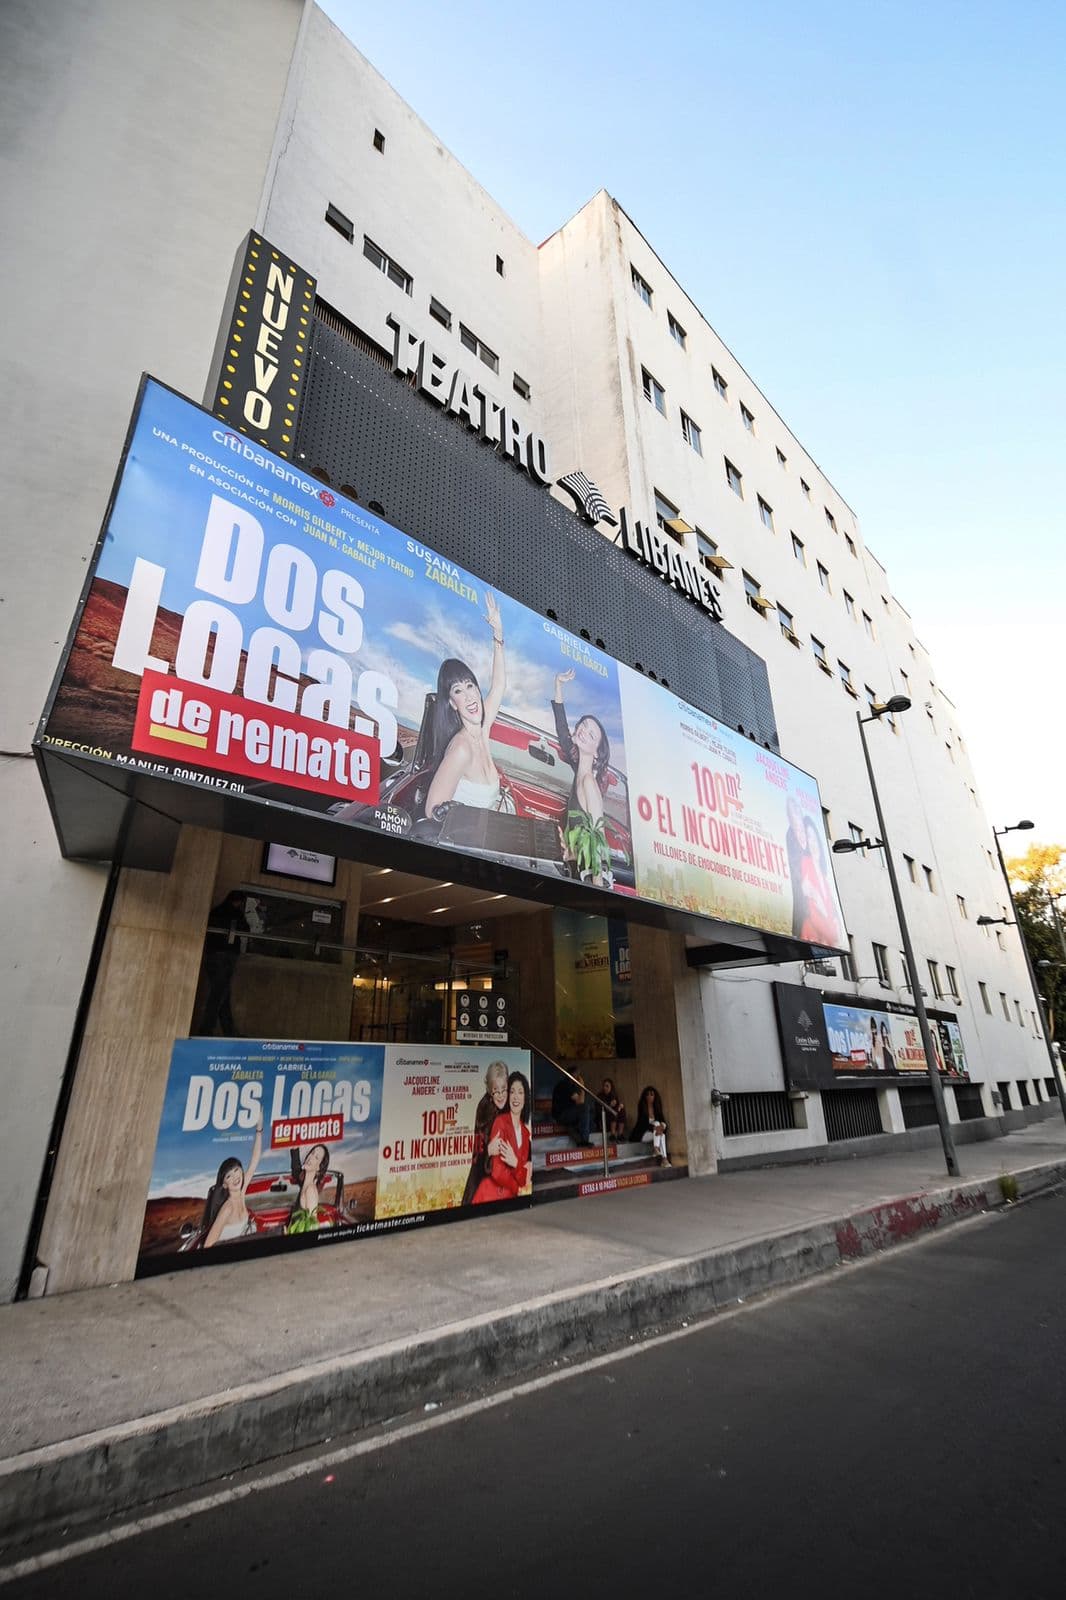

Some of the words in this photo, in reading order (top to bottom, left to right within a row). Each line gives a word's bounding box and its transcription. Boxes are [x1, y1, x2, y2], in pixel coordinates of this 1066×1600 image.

[243, 261, 294, 431] NUEVO
[385, 311, 552, 488] TEATRO
[212, 429, 319, 500] citibanamex
[341, 507, 381, 536] PRESENTA
[152, 427, 179, 447] UNA
[181, 442, 254, 488] PRODUCCIÓN
[256, 485, 271, 497] DE
[272, 492, 311, 521] MORRIS
[312, 515, 347, 540] GILBERT
[348, 535, 355, 544] Y
[356, 540, 386, 563] MEJOR
[386, 556, 416, 579] TEATRO
[189, 463, 206, 477] EN
[207, 474, 274, 514] ASOCIACIÓN
[276, 510, 298, 527] CON
[302, 522, 328, 543] JUAN
[406, 540, 461, 580] SUSANA
[425, 563, 479, 605] ZABALETA
[543, 621, 591, 656] GABRIELA
[42, 734, 113, 760] DIRECCIÓN
[149, 687, 211, 736] de
[216, 707, 372, 790] remate
[375, 810, 407, 827] RAMÓN
[388, 806, 398, 815] DE
[656, 793, 677, 837] EL
[682, 804, 789, 879] INCONVENIENTE
[653, 841, 688, 863] MILLONES
[209, 1063, 242, 1071] SUSANA
[277, 1063, 313, 1071] GABRIELA
[403, 1076, 441, 1086] JACQUELINE
[412, 1086, 436, 1096] ANDERE
[274, 1123, 291, 1138] de
[291, 1118, 341, 1142] remate
[395, 1140, 405, 1161] EL
